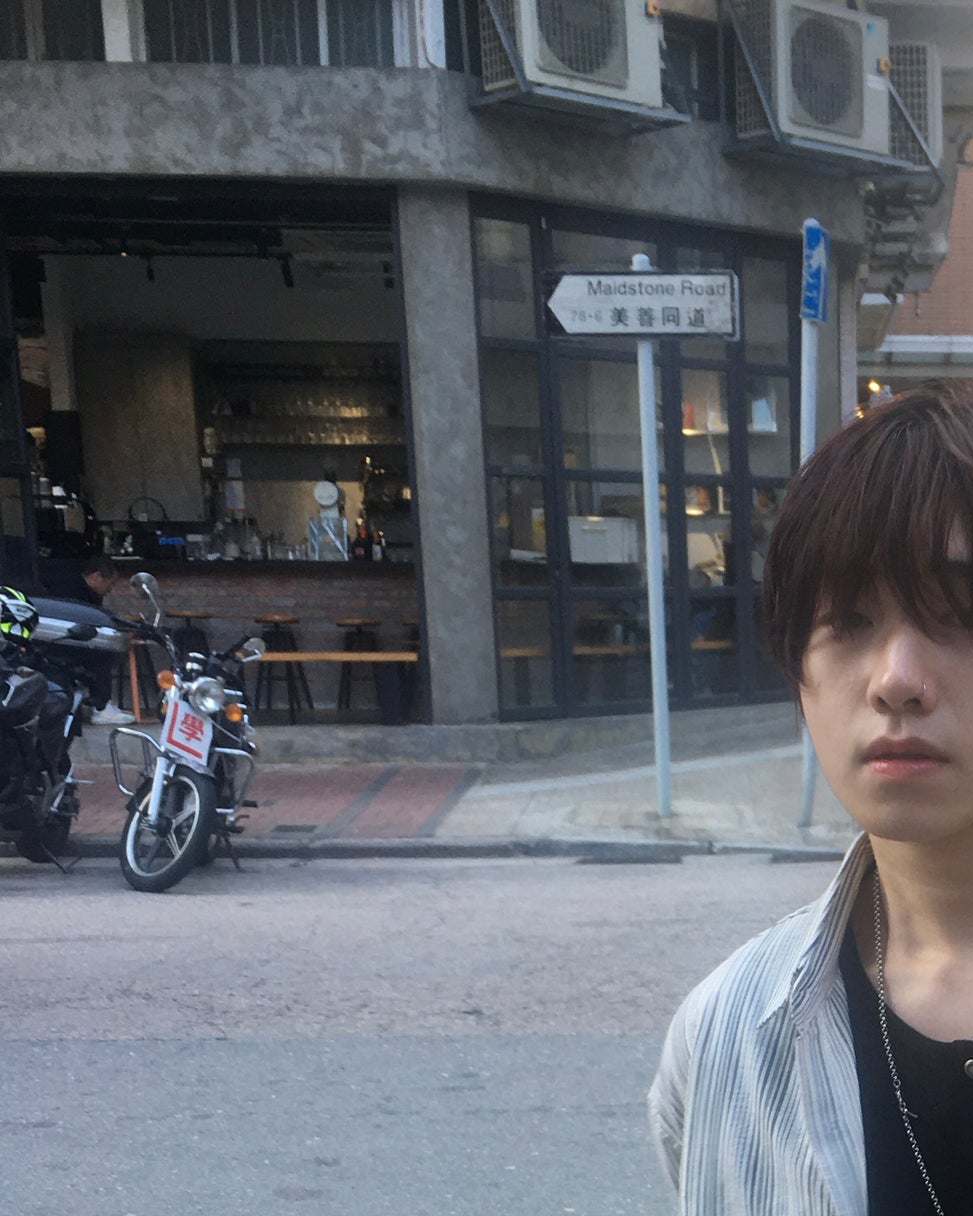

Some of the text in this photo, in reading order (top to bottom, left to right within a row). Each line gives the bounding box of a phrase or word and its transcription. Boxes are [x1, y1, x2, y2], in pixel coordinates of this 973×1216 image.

[587, 279, 726, 296] Maidstone Road
[610, 306, 705, 328] 美善同道
[178, 712, 205, 742] 學
